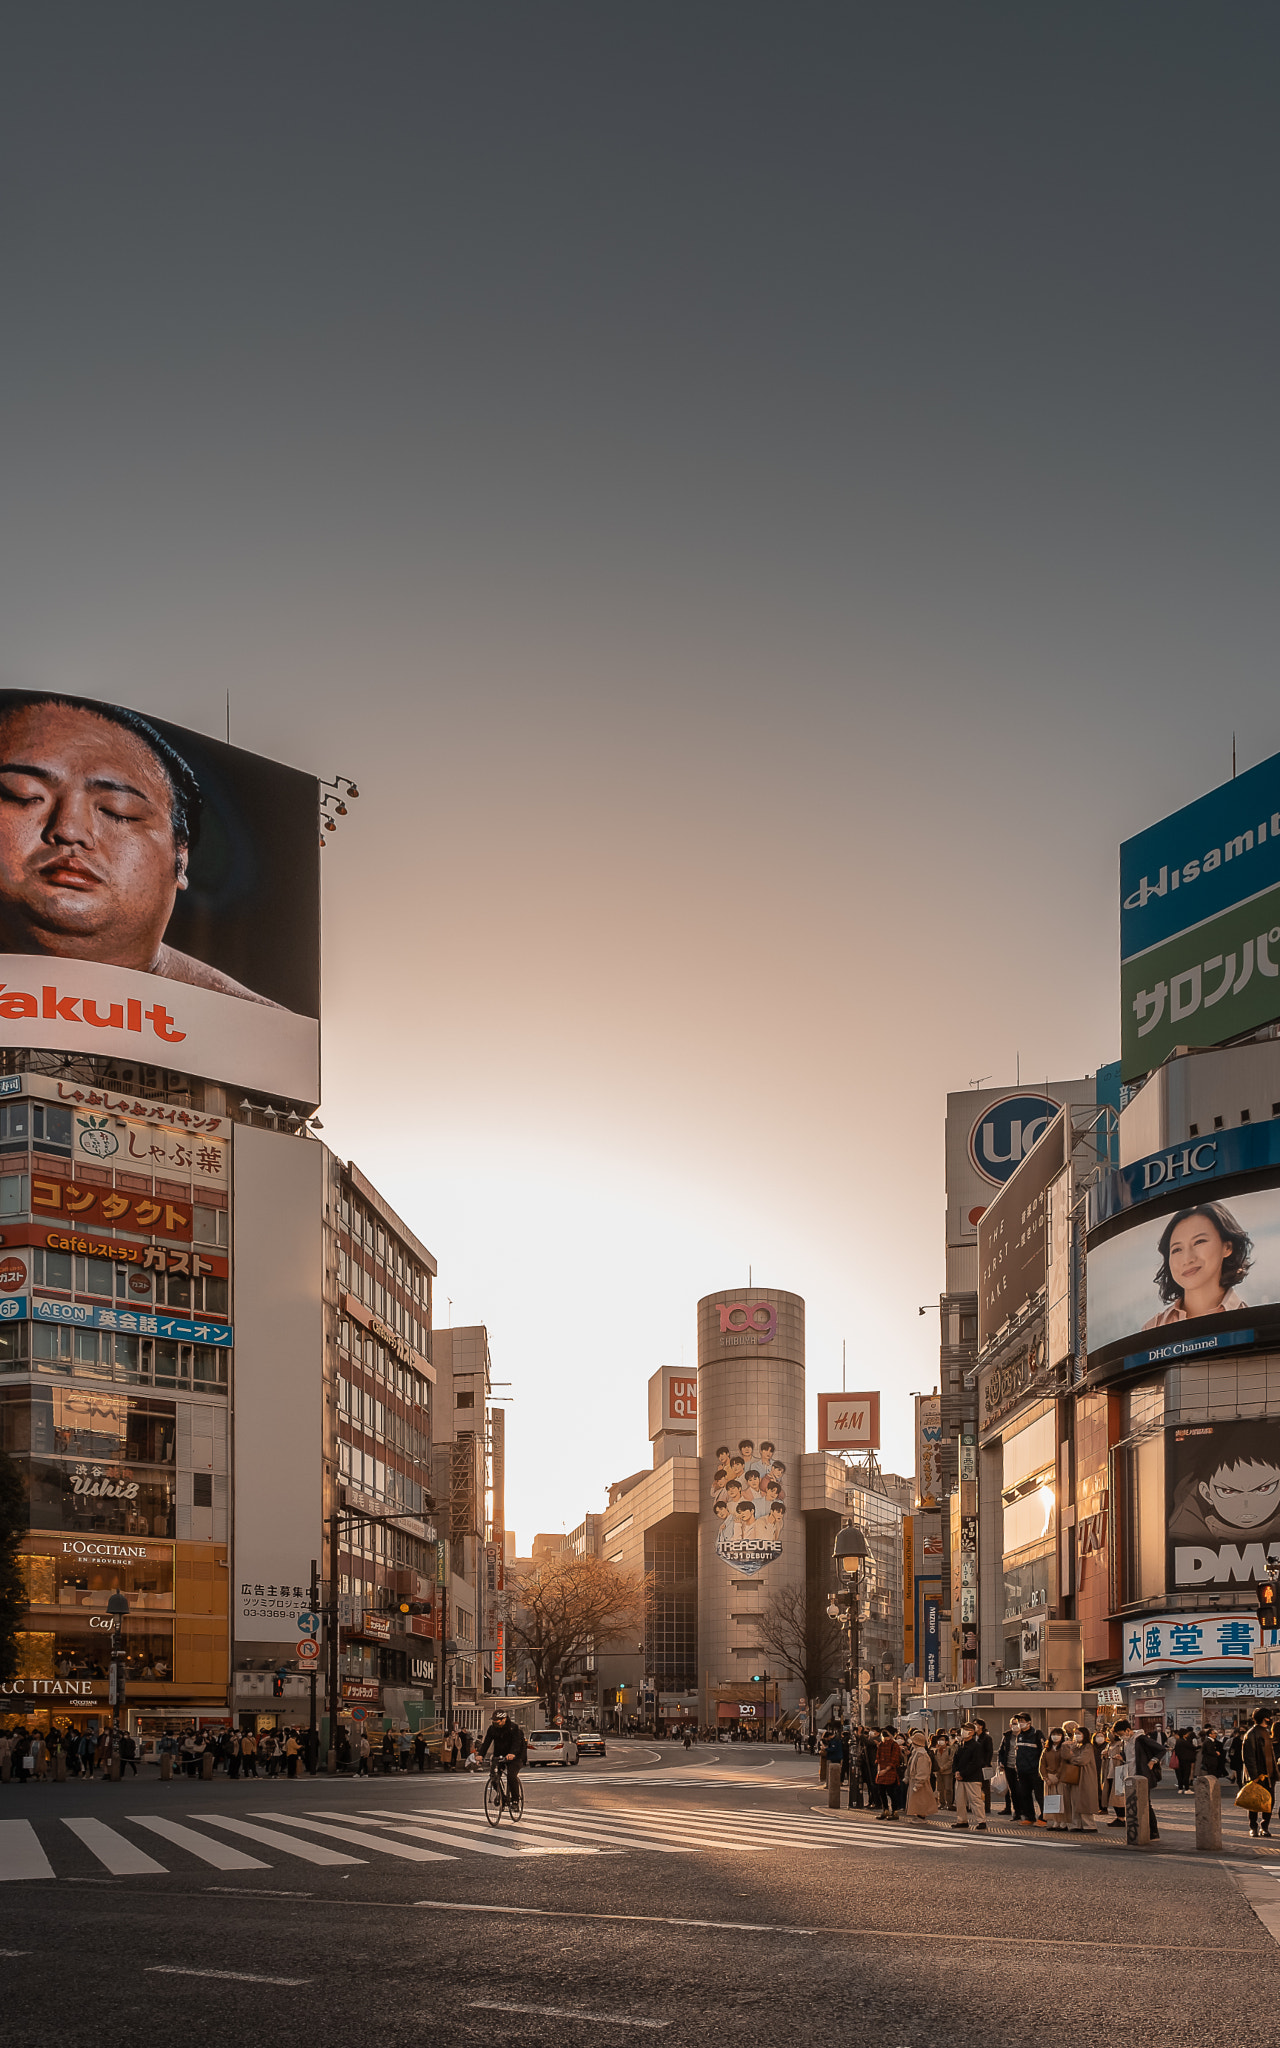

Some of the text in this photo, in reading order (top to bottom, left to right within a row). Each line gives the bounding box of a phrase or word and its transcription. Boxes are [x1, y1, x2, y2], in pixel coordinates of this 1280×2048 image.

[0, 983, 187, 1043] akult
[58, 1082, 222, 1132] しゃぶしゃぶバイキング
[128, 1131, 222, 1174] しゃぶ葉
[1142, 1141, 1218, 1190] DHC
[33, 1180, 188, 1231] コンタクト
[989, 1218, 1005, 1249] THE
[142, 1246, 213, 1278] ガスト
[983, 1241, 1009, 1285] FIRST
[985, 1274, 1007, 1311] TAKE
[1, 1302, 17, 1315] 6F
[39, 1302, 229, 1341] AEON 英会話イーオン
[715, 1302, 778, 1345] 109
[719, 1335, 758, 1346] SHIBUYA
[1148, 1337, 1218, 1361] DHC Channel
[674, 1382, 697, 1398] UN
[674, 1399, 697, 1416] QL
[833, 1411, 864, 1430] H&M
[717, 1540, 782, 1552] TREASURE
[1174, 1541, 1280, 1585] DM
[89, 1616, 116, 1631] Caf
[243, 1608, 304, 1619] 03-3369-81
[411, 1658, 434, 1680] LUSH
